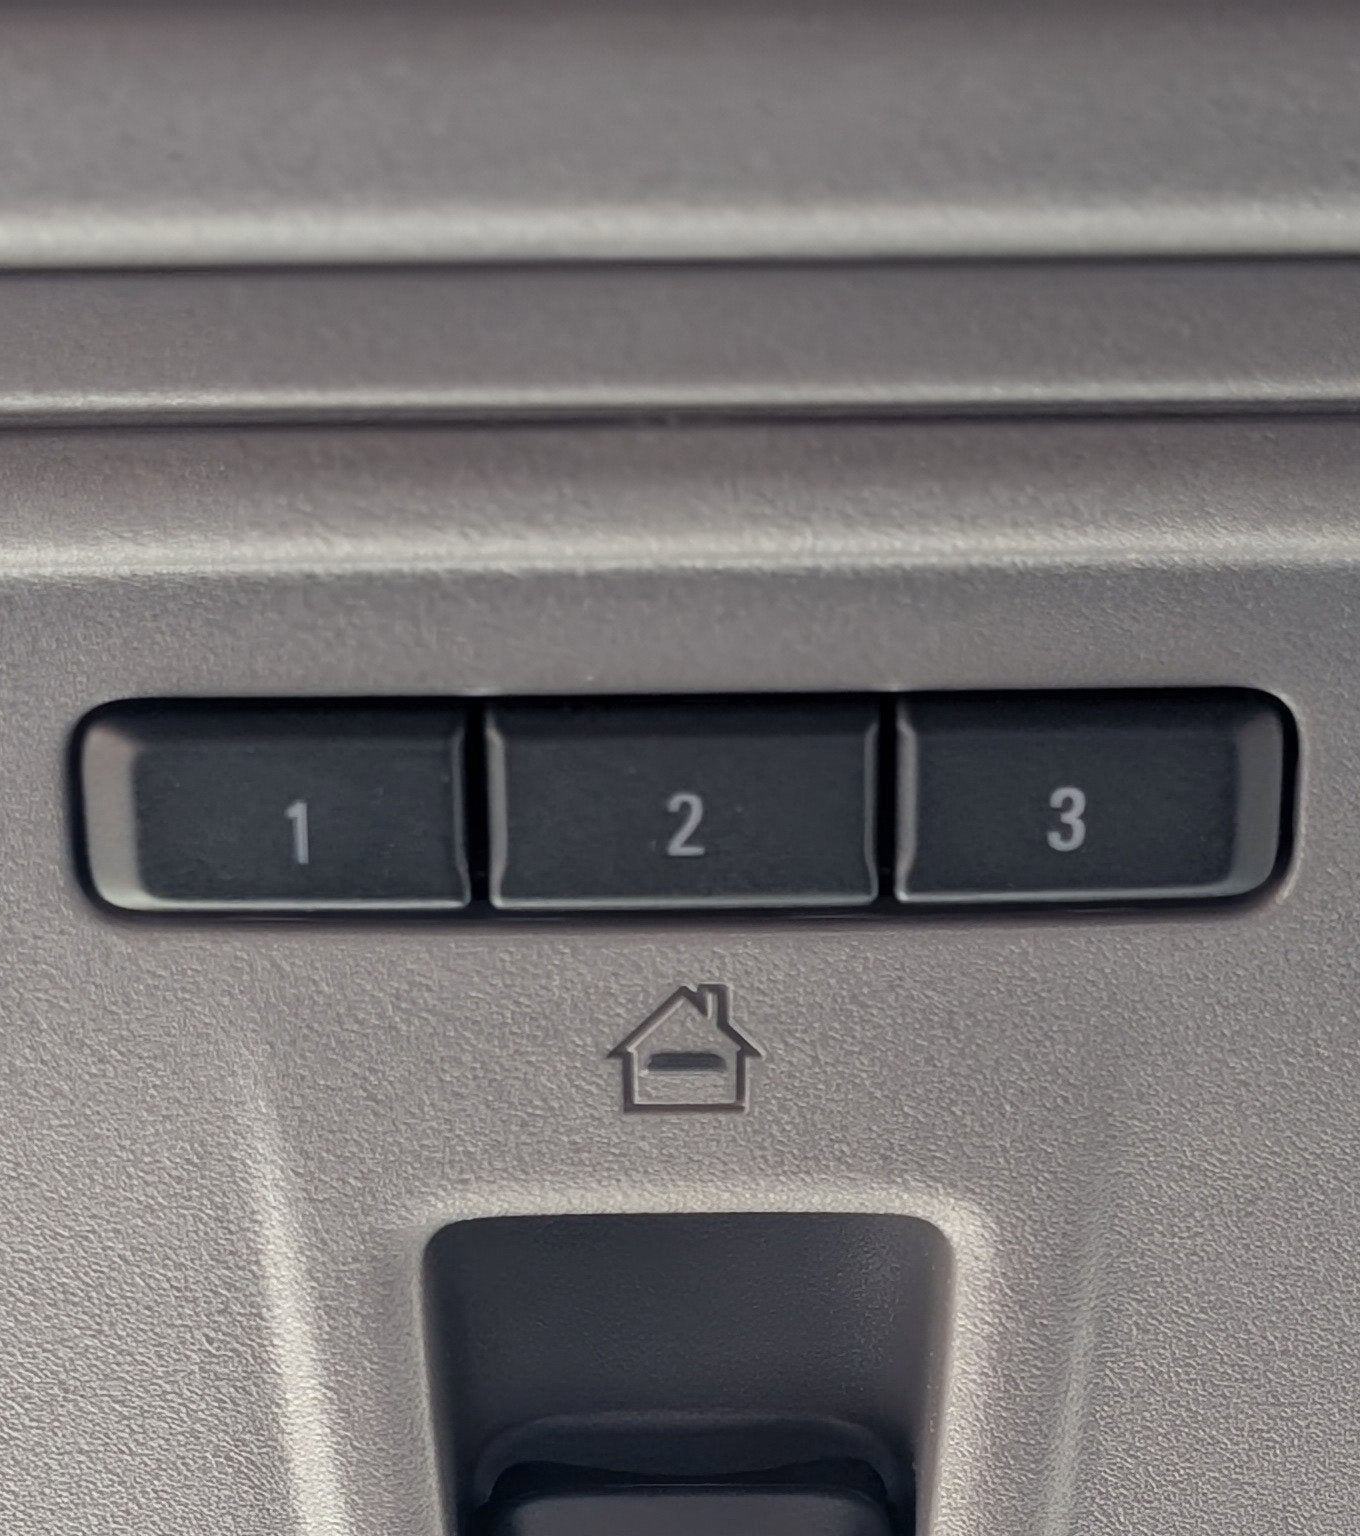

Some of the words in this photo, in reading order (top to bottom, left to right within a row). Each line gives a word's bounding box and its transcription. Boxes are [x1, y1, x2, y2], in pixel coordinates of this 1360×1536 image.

[284, 801, 310, 865] 1
[666, 793, 707, 857] 2
[1046, 786, 1087, 853] 3
